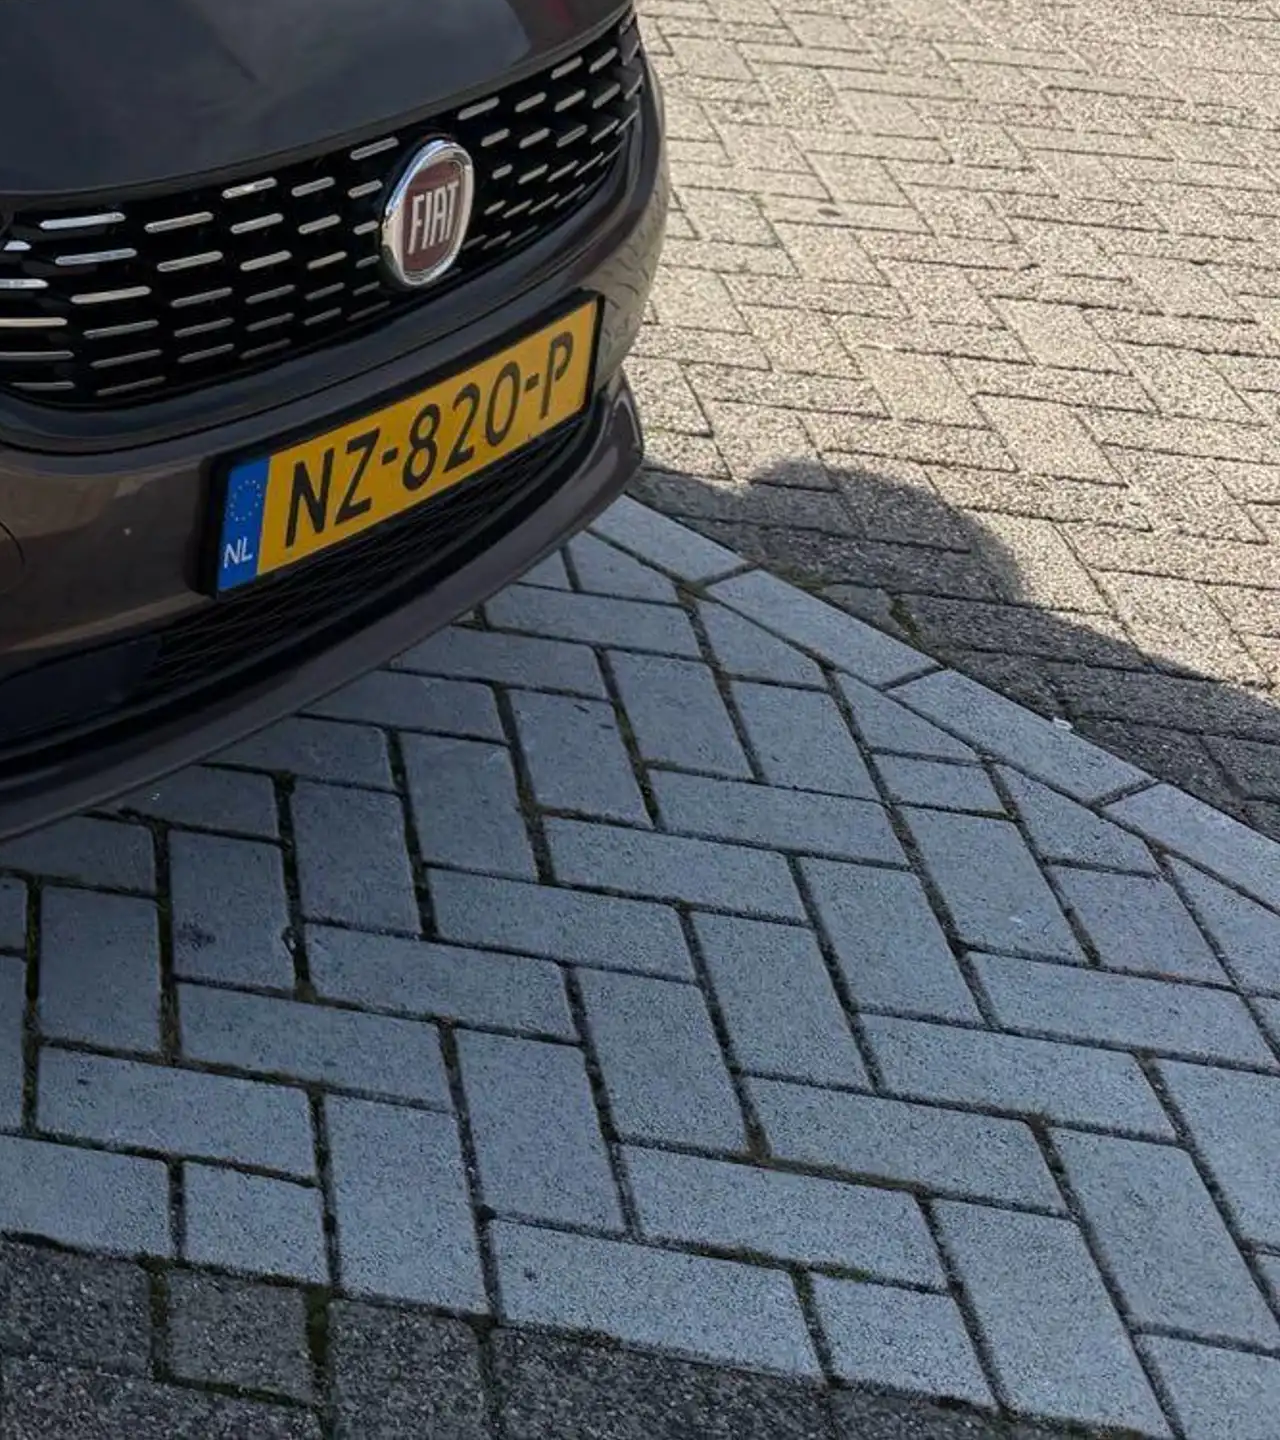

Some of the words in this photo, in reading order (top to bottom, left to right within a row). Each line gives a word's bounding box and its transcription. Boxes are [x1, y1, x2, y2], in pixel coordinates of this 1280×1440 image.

[408, 180, 460, 255] FIAT
[285, 330, 574, 549] NZ-820-P
[223, 536, 253, 568] NL
